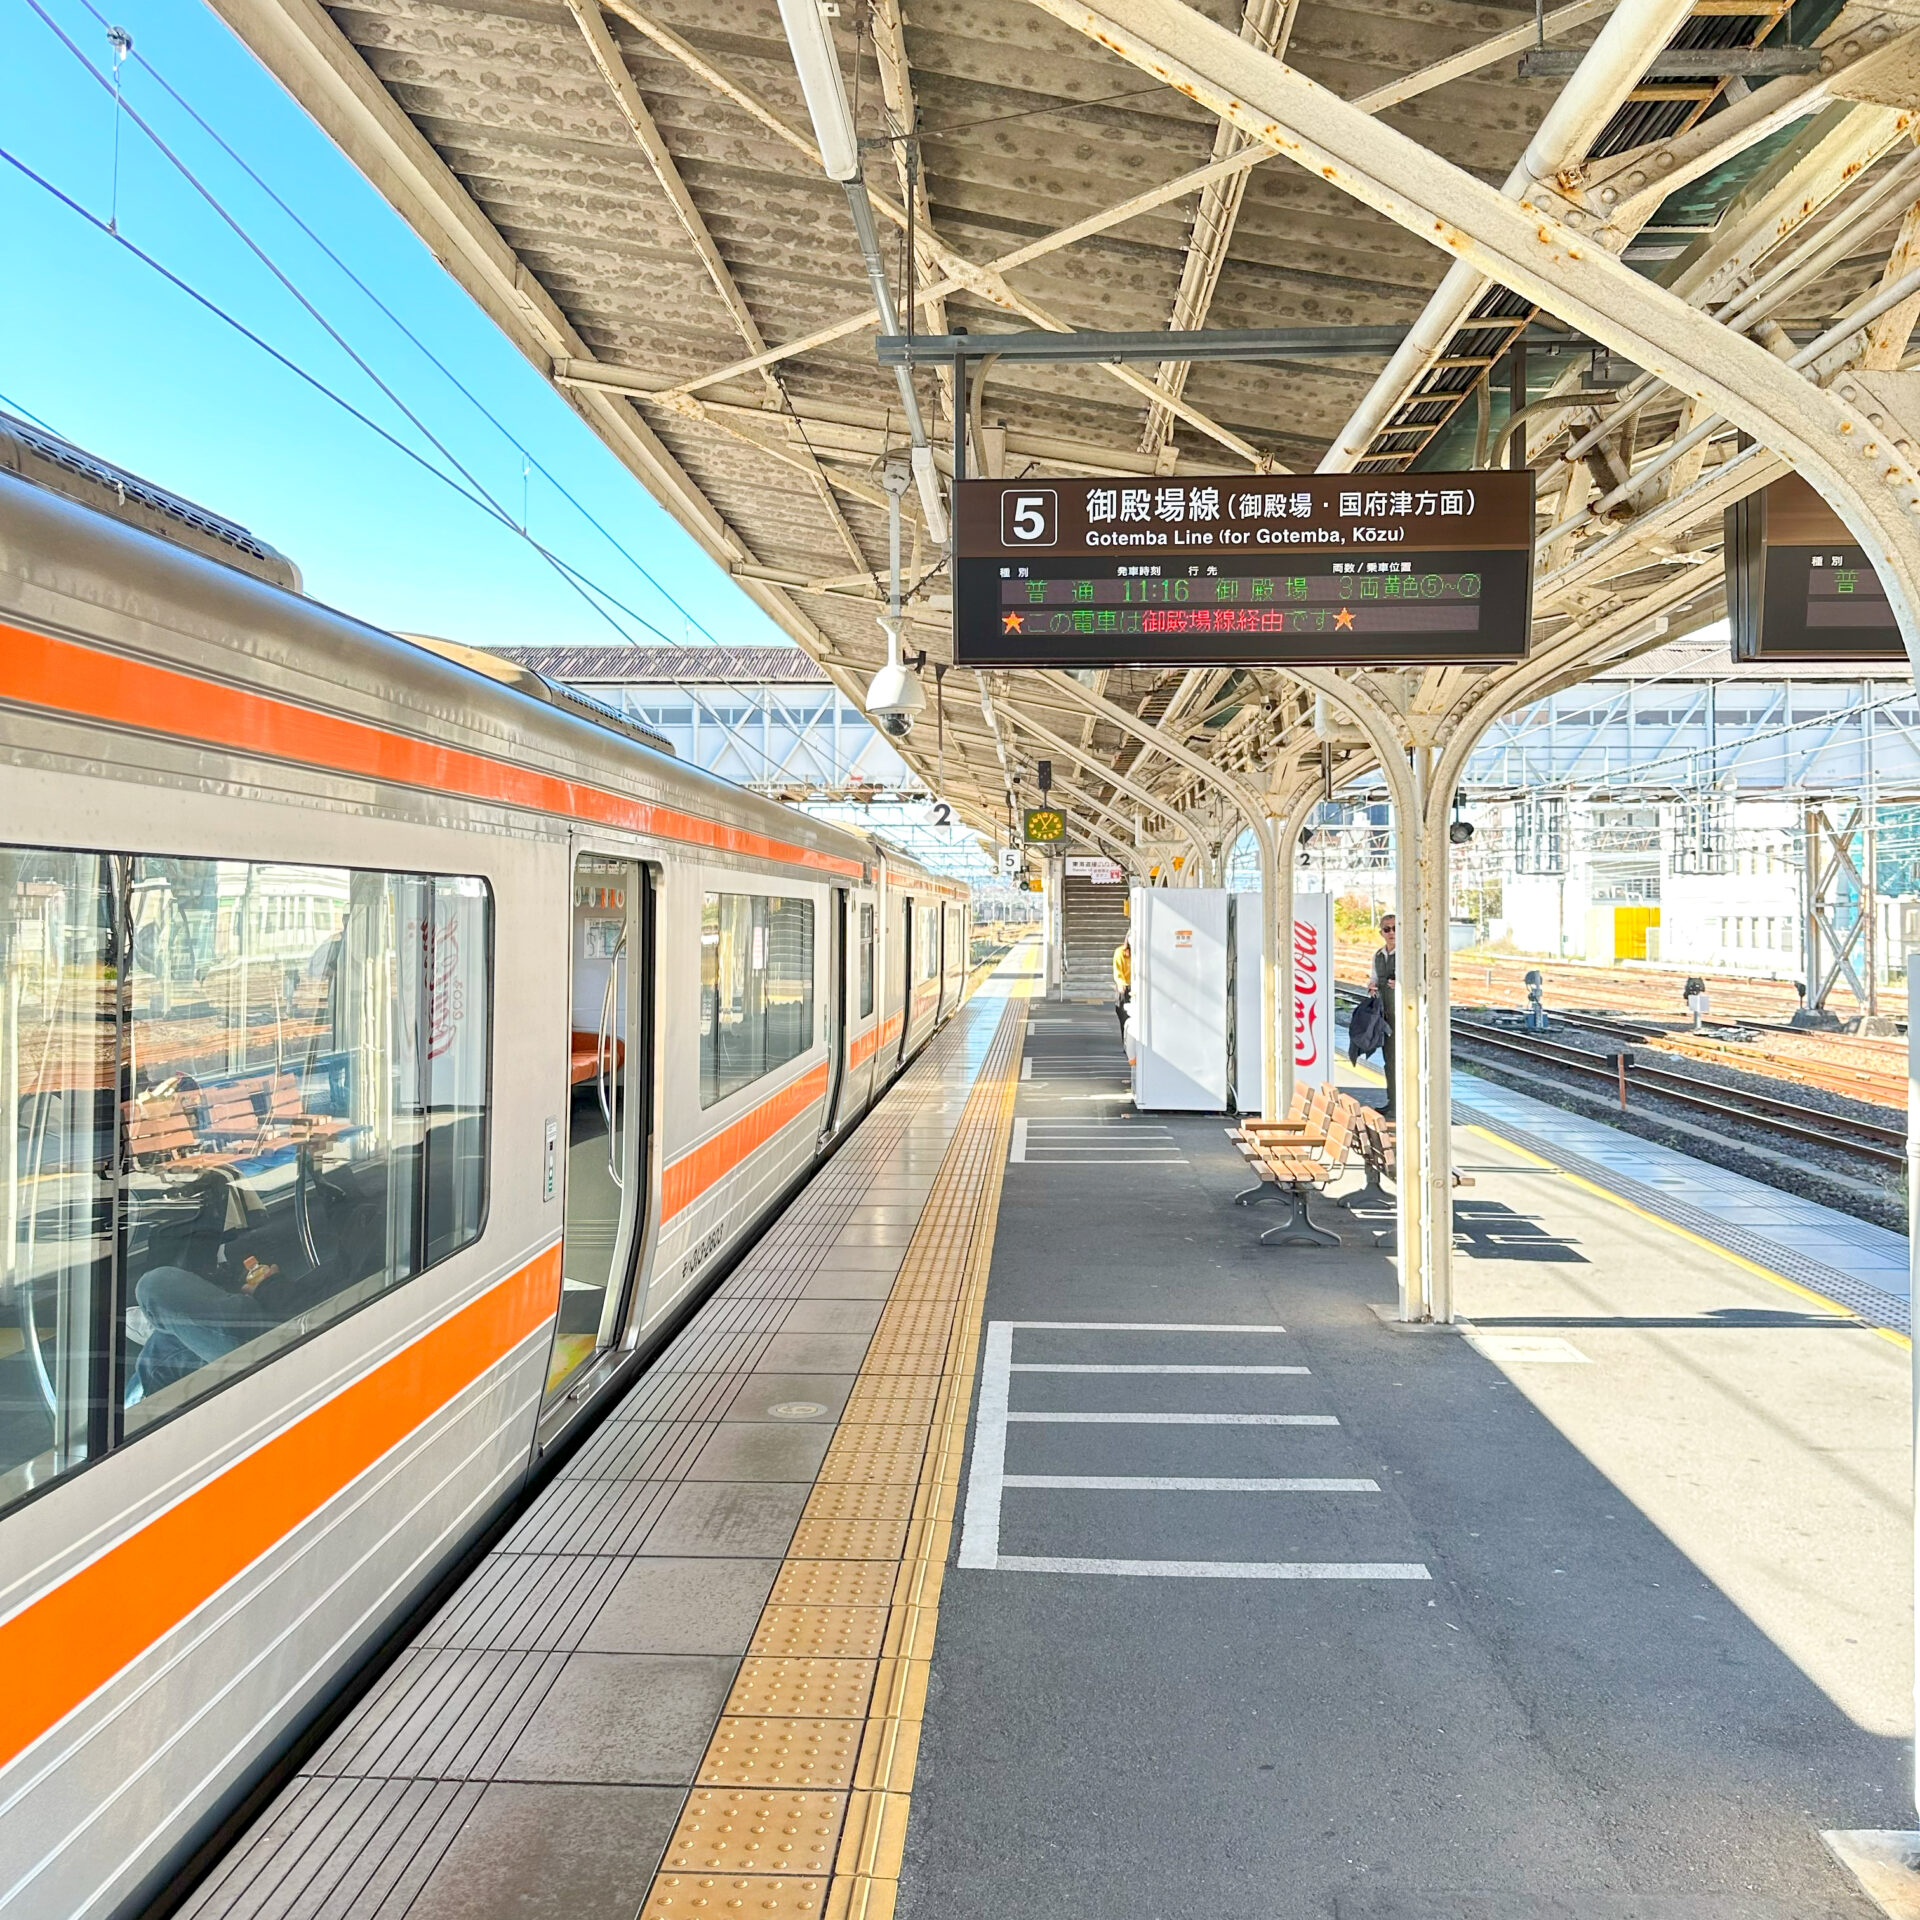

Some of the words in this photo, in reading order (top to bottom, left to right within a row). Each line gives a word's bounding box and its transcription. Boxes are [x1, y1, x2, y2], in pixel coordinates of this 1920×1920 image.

[1085, 486, 1221, 524] 御殿場線
[1012, 497, 1045, 541] 5
[1085, 529, 1168, 546] Gotemba
[1174, 529, 1213, 545] Line
[1218, 529, 1251, 545] (for
[1256, 528, 1346, 546] Gotemba,
[1352, 526, 1405, 544] Kōzu)
[1117, 566, 1161, 577] 発車時刻
[1188, 565, 1218, 576] 行先
[1811, 556, 1844, 567] 種別
[1123, 578, 1190, 603] 11:16
[1834, 569, 1859, 593] 普
[933, 803, 951, 826] 2
[1005, 854, 1015, 867] 5
[1300, 853, 1311, 865] 2
